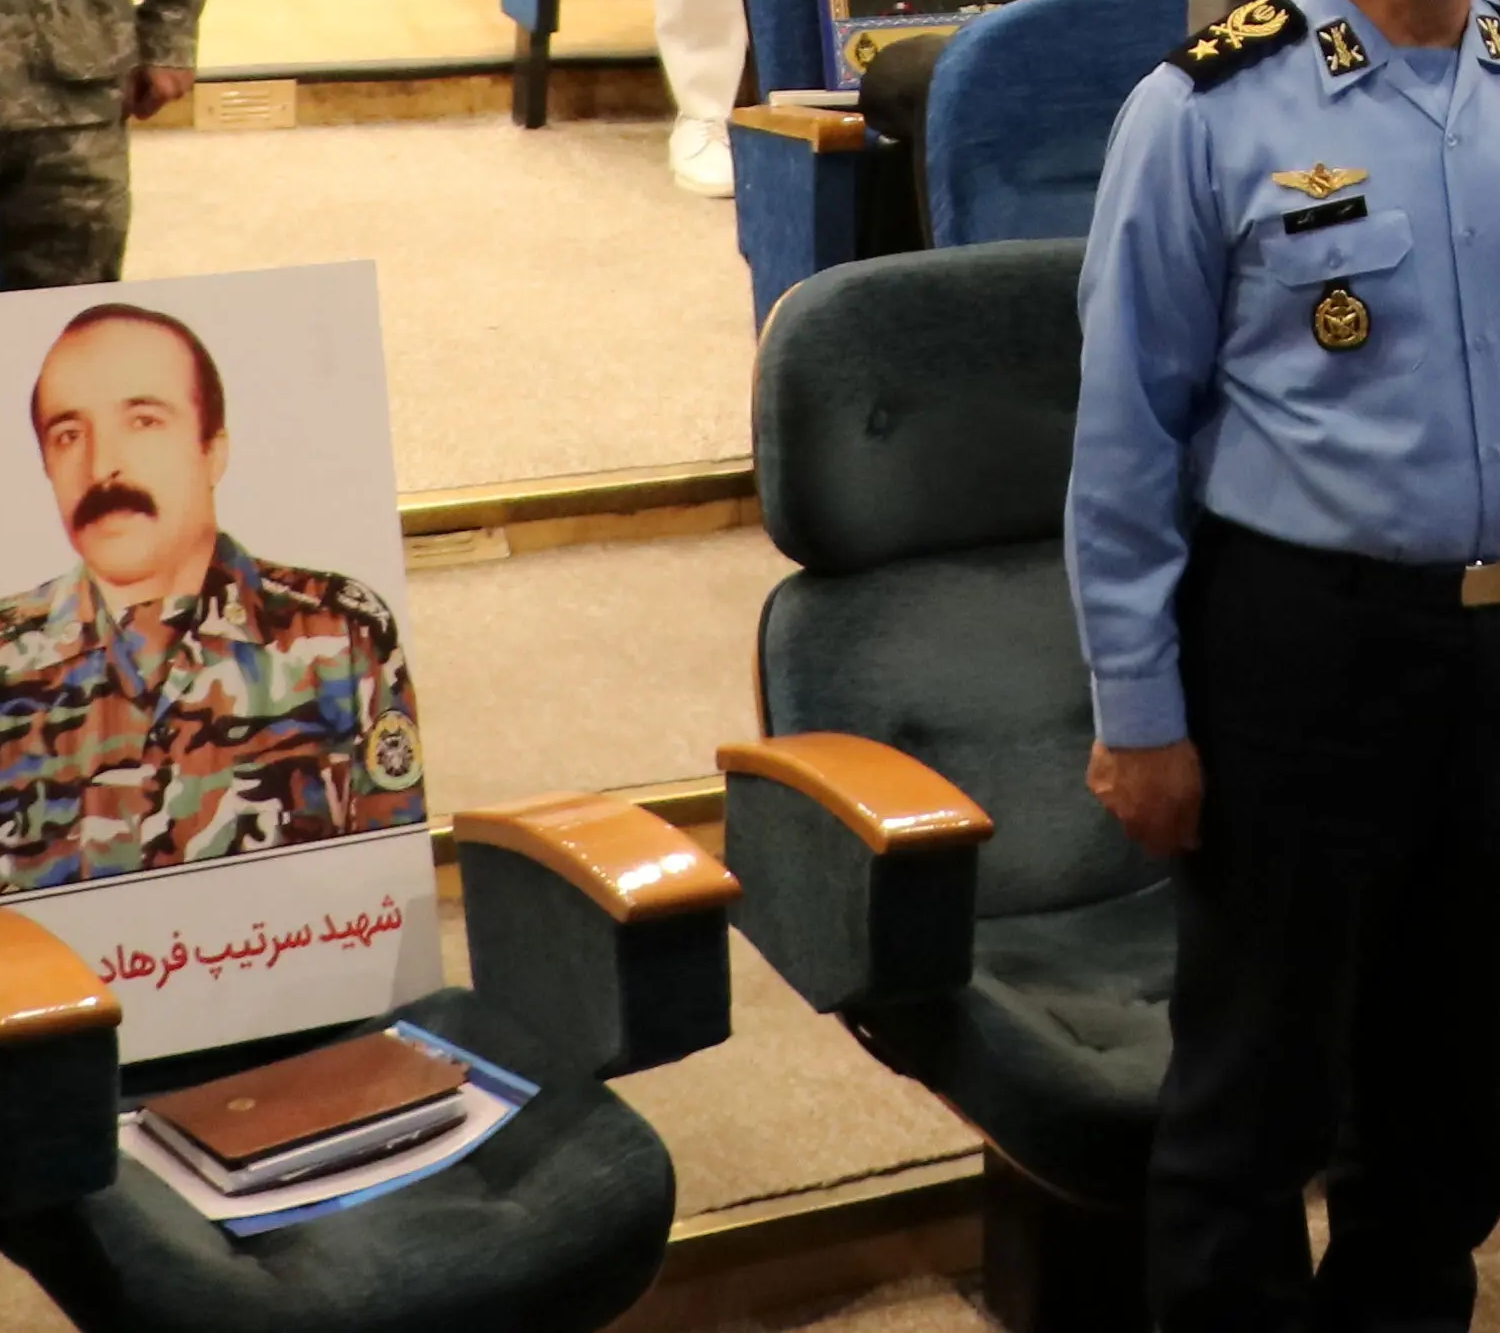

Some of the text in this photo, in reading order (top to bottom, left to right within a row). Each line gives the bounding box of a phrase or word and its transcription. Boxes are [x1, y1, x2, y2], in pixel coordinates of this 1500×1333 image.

[98, 893, 404, 991] شهید سرتیپ فرهاد
